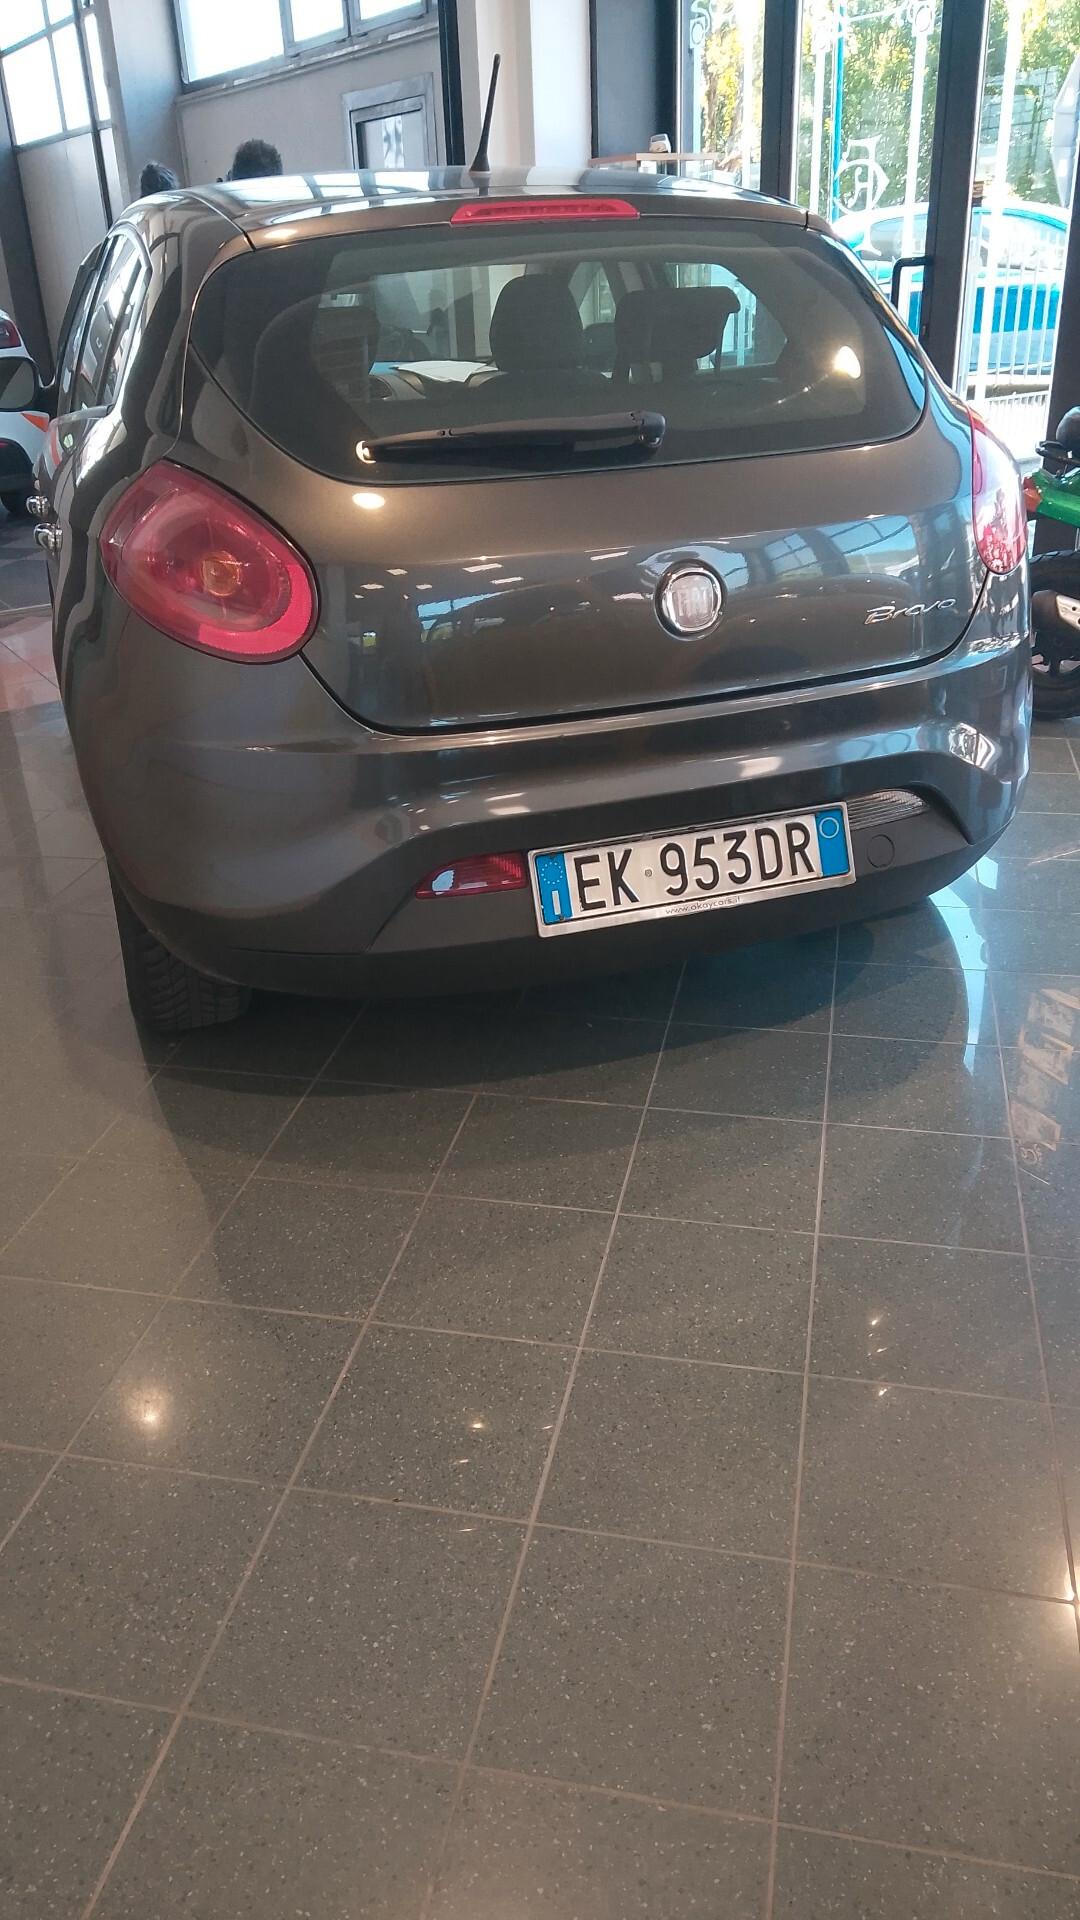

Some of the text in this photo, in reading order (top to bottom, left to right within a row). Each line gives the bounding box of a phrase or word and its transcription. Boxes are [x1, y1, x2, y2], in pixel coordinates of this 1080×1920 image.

[864, 598, 956, 625] Bravo
[573, 848, 640, 911] EK
[659, 821, 815, 897] 953DR
